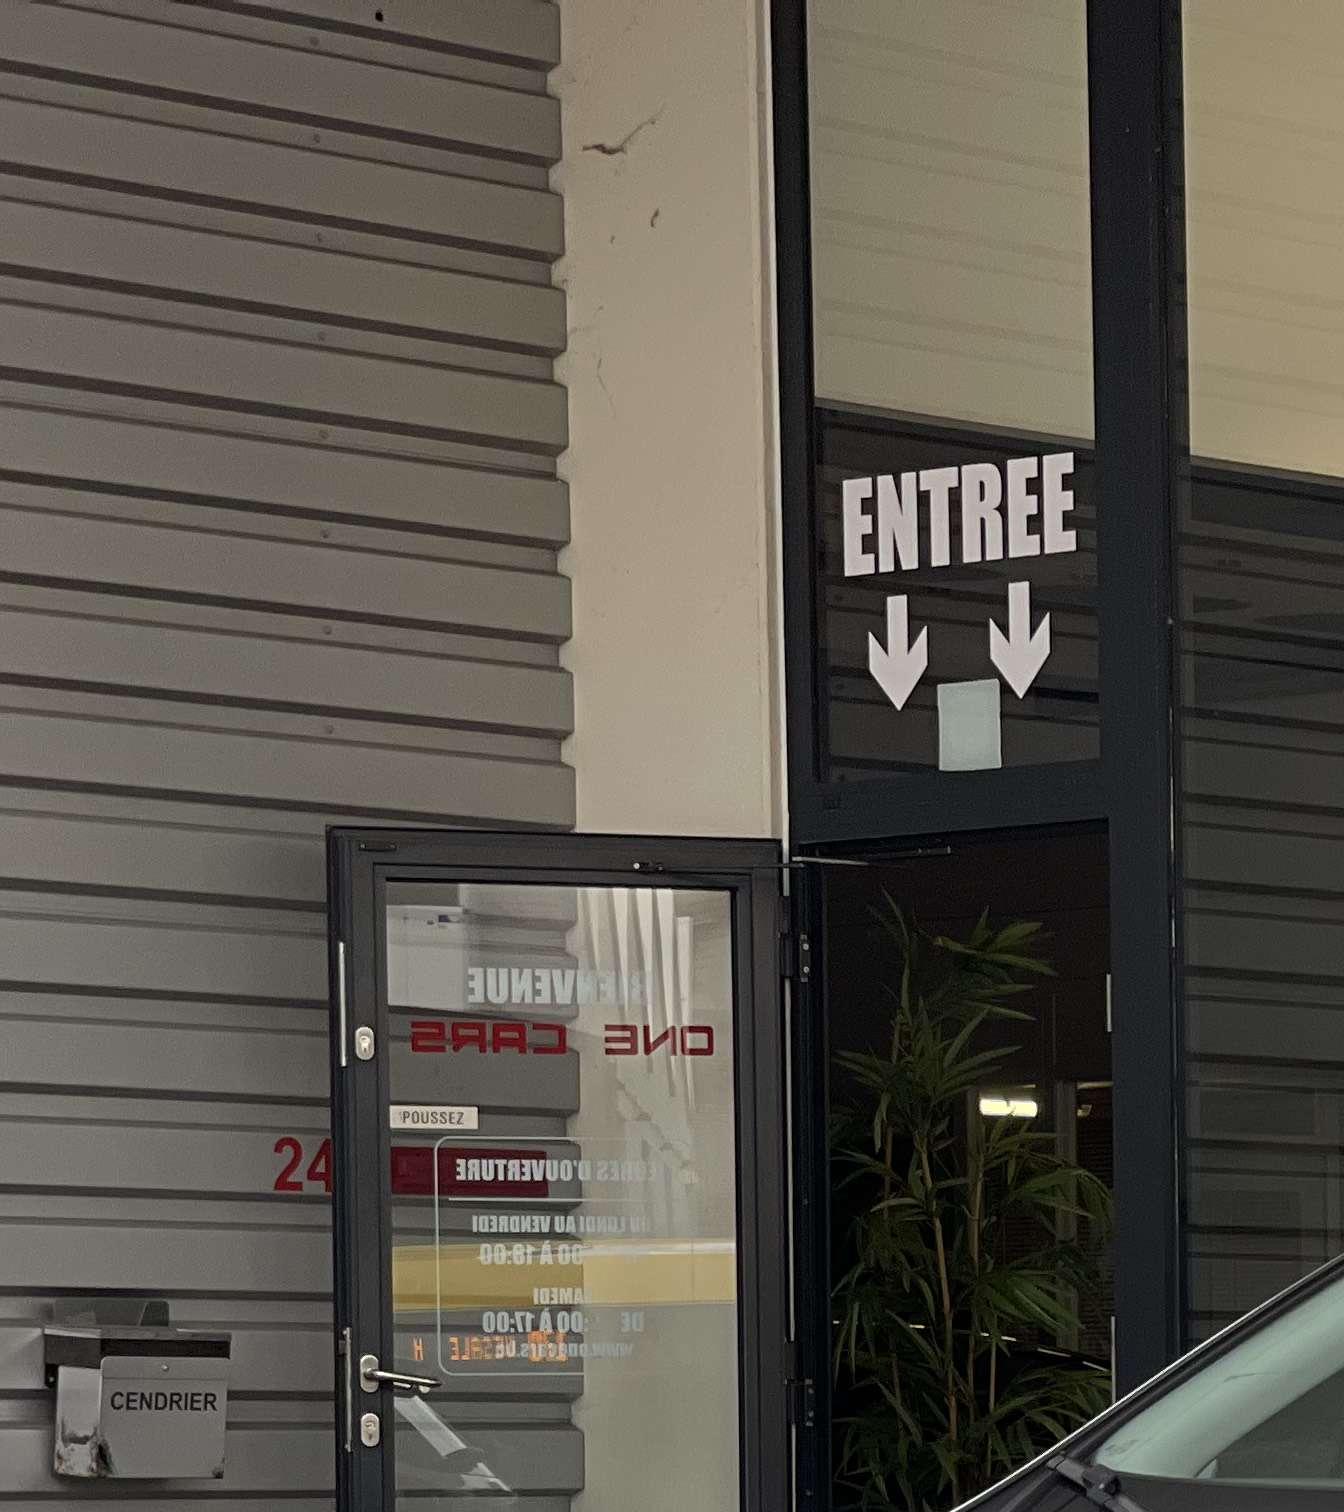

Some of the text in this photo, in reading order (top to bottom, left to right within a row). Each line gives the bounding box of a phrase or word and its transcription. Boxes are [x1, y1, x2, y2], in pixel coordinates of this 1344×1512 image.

[843, 452, 1077, 577] ENTREE
[402, 1111, 465, 1125] POUSSEZ
[110, 1391, 217, 1411] CENDRIER
